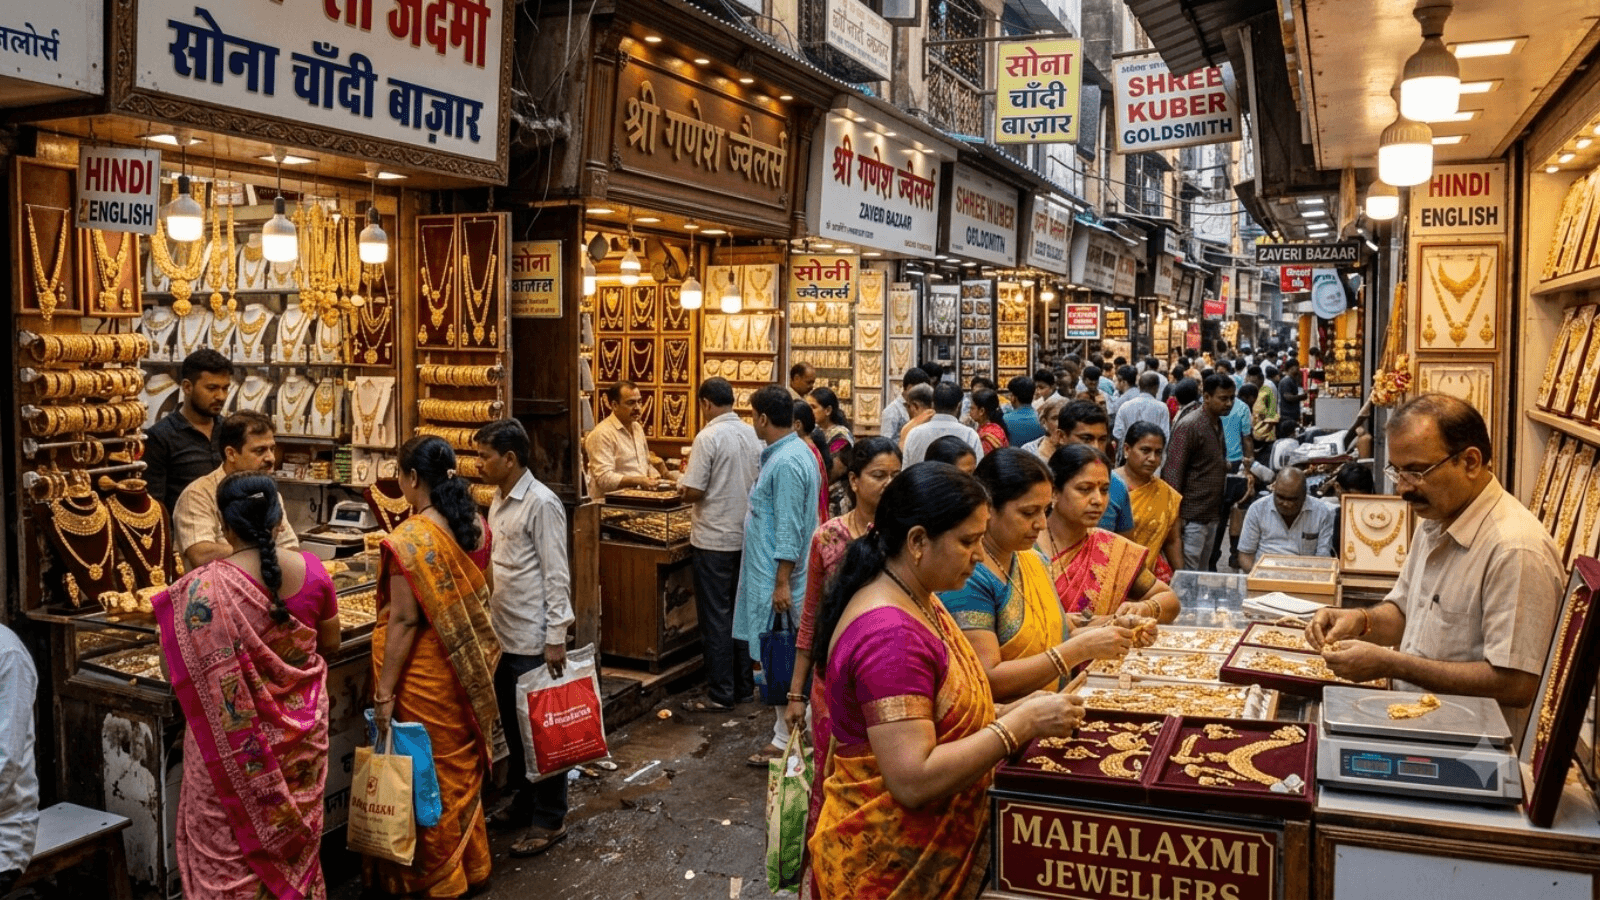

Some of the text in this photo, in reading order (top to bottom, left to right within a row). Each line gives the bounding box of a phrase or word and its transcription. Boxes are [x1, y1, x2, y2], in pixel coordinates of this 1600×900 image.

[168, 6, 280, 96] सोना
[292, 41, 378, 118] चाँदी
[388, 77, 483, 143] बाज़ार
[1006, 46, 1073, 77] सोना
[1009, 81, 1067, 109] चाँदी
[1128, 66, 1223, 97] SHREE
[1128, 92, 1227, 123] KUBER
[624, 80, 660, 154] श्री
[665, 98, 725, 172] गणेश
[1001, 115, 1072, 139] बाज़ार
[1124, 118, 1232, 144] GOLDSMITH
[85, 156, 153, 195] HINDI
[833, 134, 854, 187] श्री
[857, 146, 894, 200] गणेश
[1429, 172, 1490, 197] HINDI
[89, 200, 153, 226] ENGLISH
[1421, 206, 1498, 227] ENGLISH
[1259, 247, 1356, 261] ZAVERI BAZAAR
[793, 259, 852, 281] सोनी
[1011, 812, 1260, 876] MAHALAXMI
[1036, 858, 1240, 900] JEWELLERS
